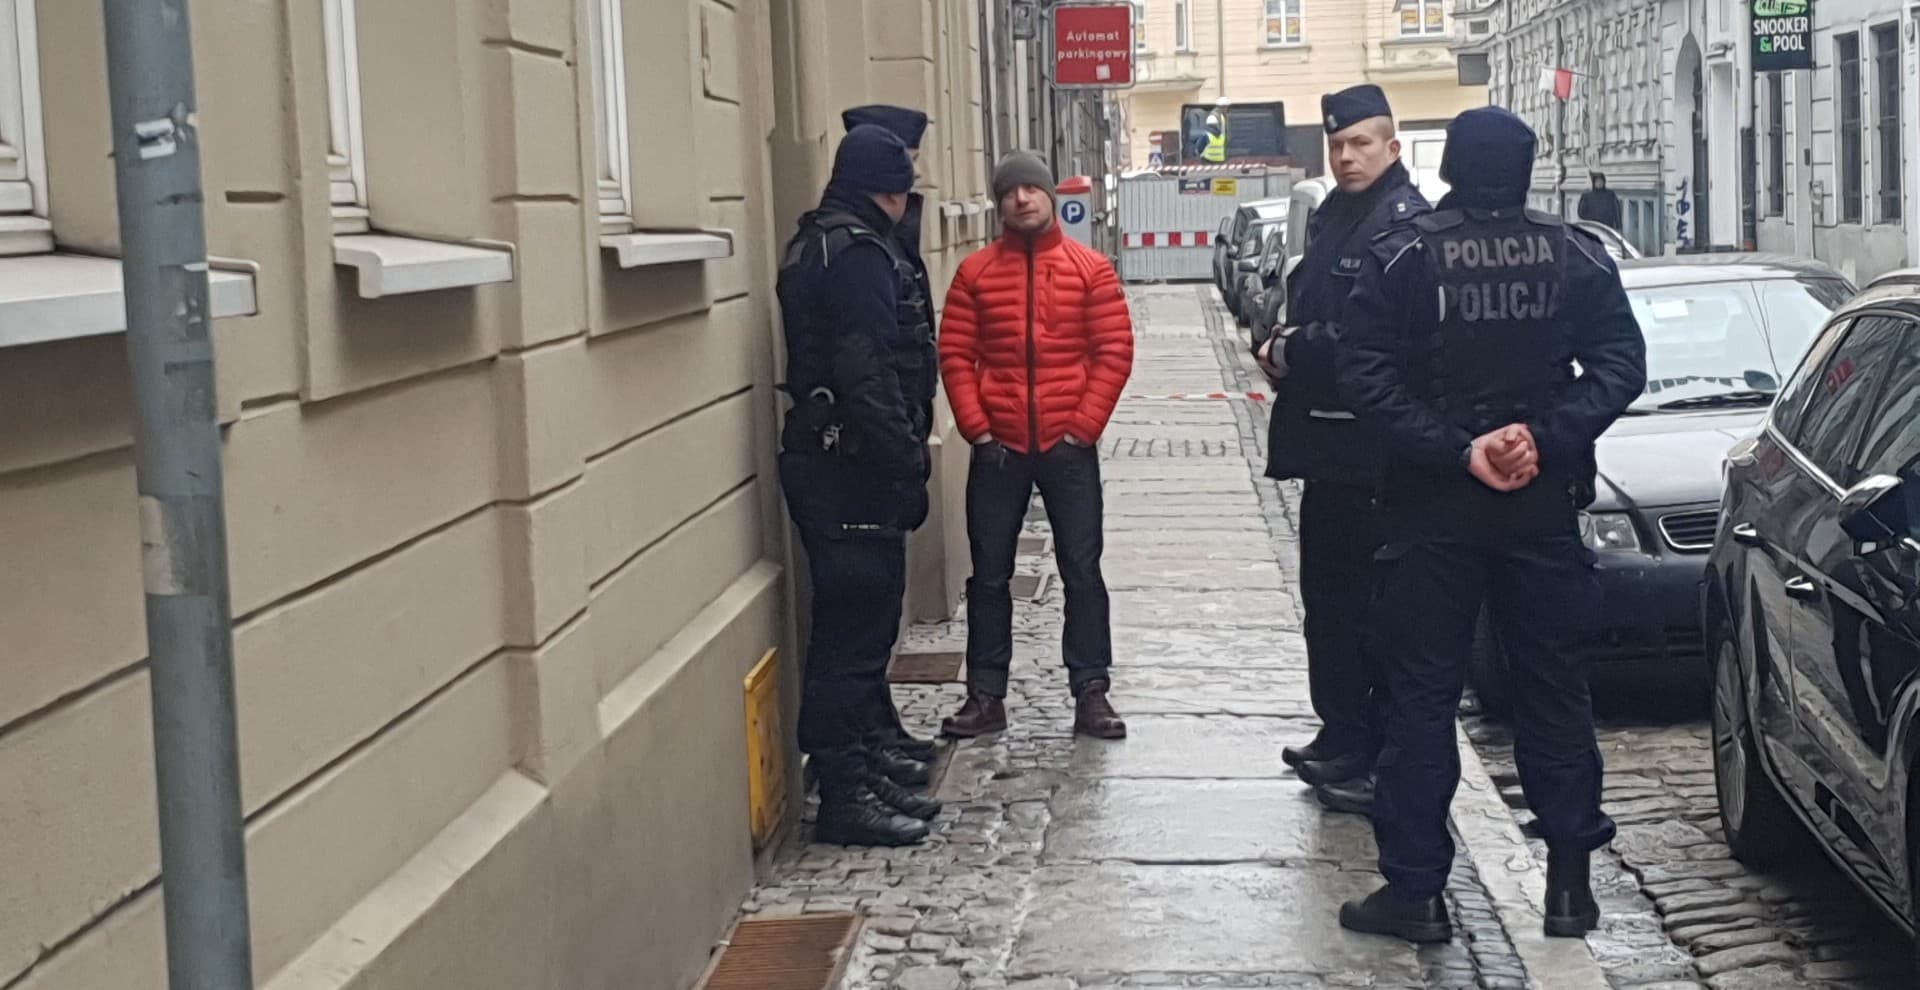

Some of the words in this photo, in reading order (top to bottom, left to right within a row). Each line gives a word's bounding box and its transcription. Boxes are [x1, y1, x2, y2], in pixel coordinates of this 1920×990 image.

[1753, 16, 1808, 36] SNOOKER
[1066, 31, 1120, 41] Automat
[1057, 48, 1128, 62] parkingowy
[1067, 204, 1081, 220] P
[1443, 235, 1554, 269] POLICJA
